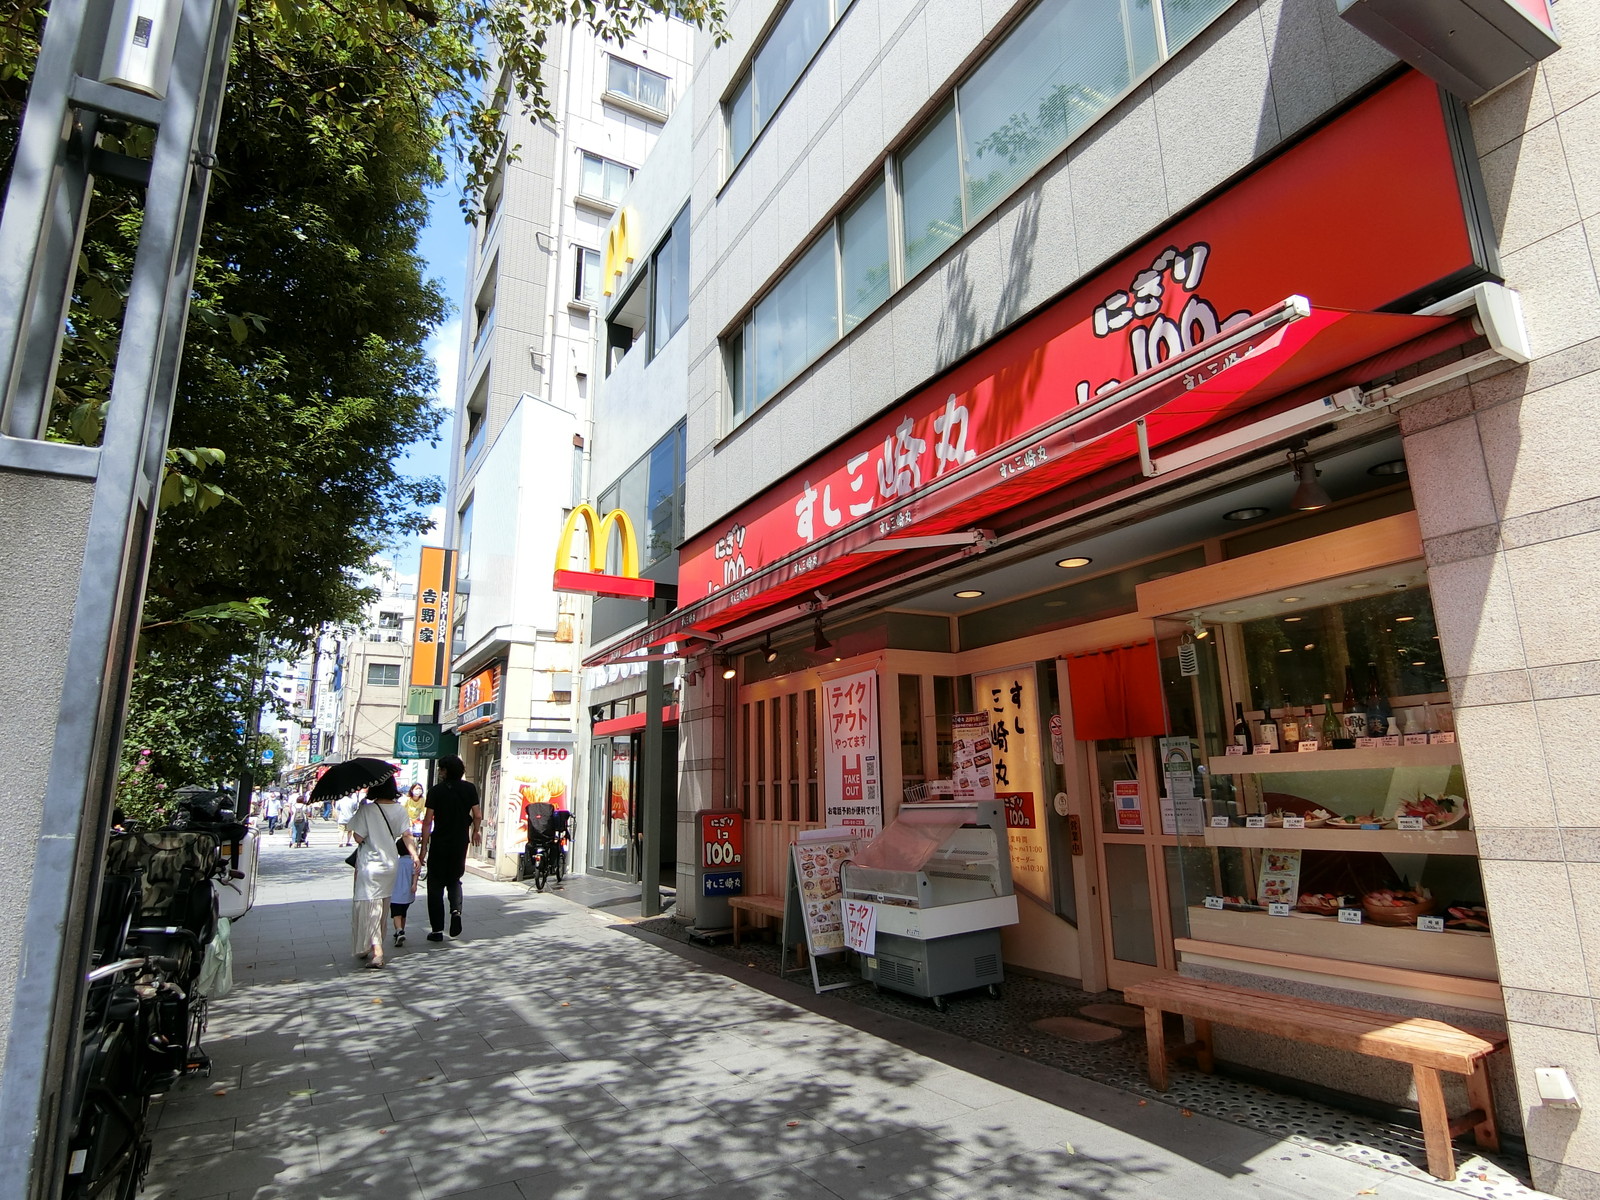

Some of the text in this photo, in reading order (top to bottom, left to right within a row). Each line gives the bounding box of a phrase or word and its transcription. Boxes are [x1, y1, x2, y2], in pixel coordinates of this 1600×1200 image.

[1091, 241, 1211, 338] にぎり
[796, 393, 976, 543] すし三崎丸
[999, 445, 1047, 479] すし三崎丸
[879, 509, 913, 534] すし三崎丸
[714, 523, 746, 560] にぎり
[793, 555, 818, 574] すし三崎丸
[419, 588, 437, 643] 吉野家
[831, 681, 866, 708] テイク
[1010, 680, 1024, 734] すし
[832, 708, 868, 734] アウト
[834, 735, 867, 749] やってます
[991, 688, 1009, 786] 三崎丸
[844, 773, 861, 784] TAKE
[845, 785, 859, 797] OUT
[710, 817, 734, 828] にぎり
[706, 842, 741, 865] 100円
[705, 878, 741, 890] すし三崎丸
